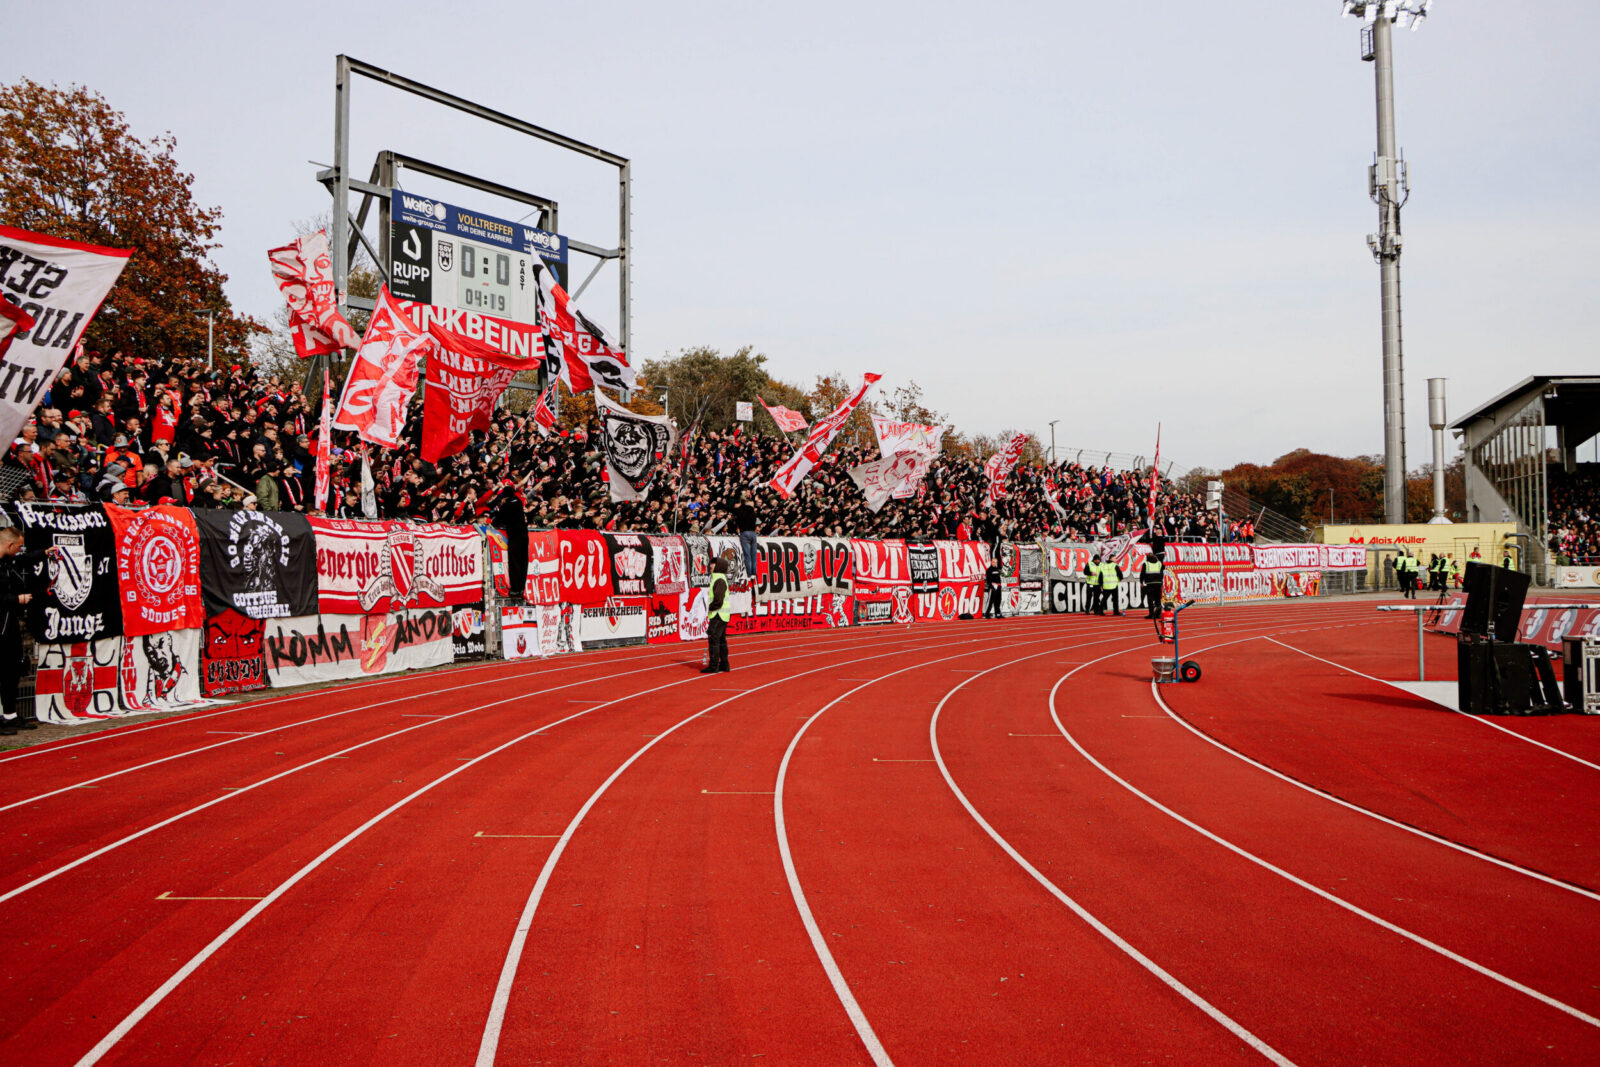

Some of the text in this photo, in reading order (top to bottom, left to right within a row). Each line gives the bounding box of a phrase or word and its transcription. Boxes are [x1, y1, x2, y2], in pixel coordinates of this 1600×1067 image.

[458, 212, 513, 236] VOLLTREFFER
[470, 226, 486, 238] DEINE
[487, 231, 513, 244] KARRIERE
[393, 260, 430, 282] RUPP
[466, 288, 505, 311] 04:19
[1368, 535, 1427, 544] Alois Müller
[316, 542, 380, 590] energie
[425, 544, 476, 580] cottbus
[560, 539, 608, 590] Geil
[821, 540, 849, 589] 02
[583, 605, 643, 618] SCHWARZHEIDE
